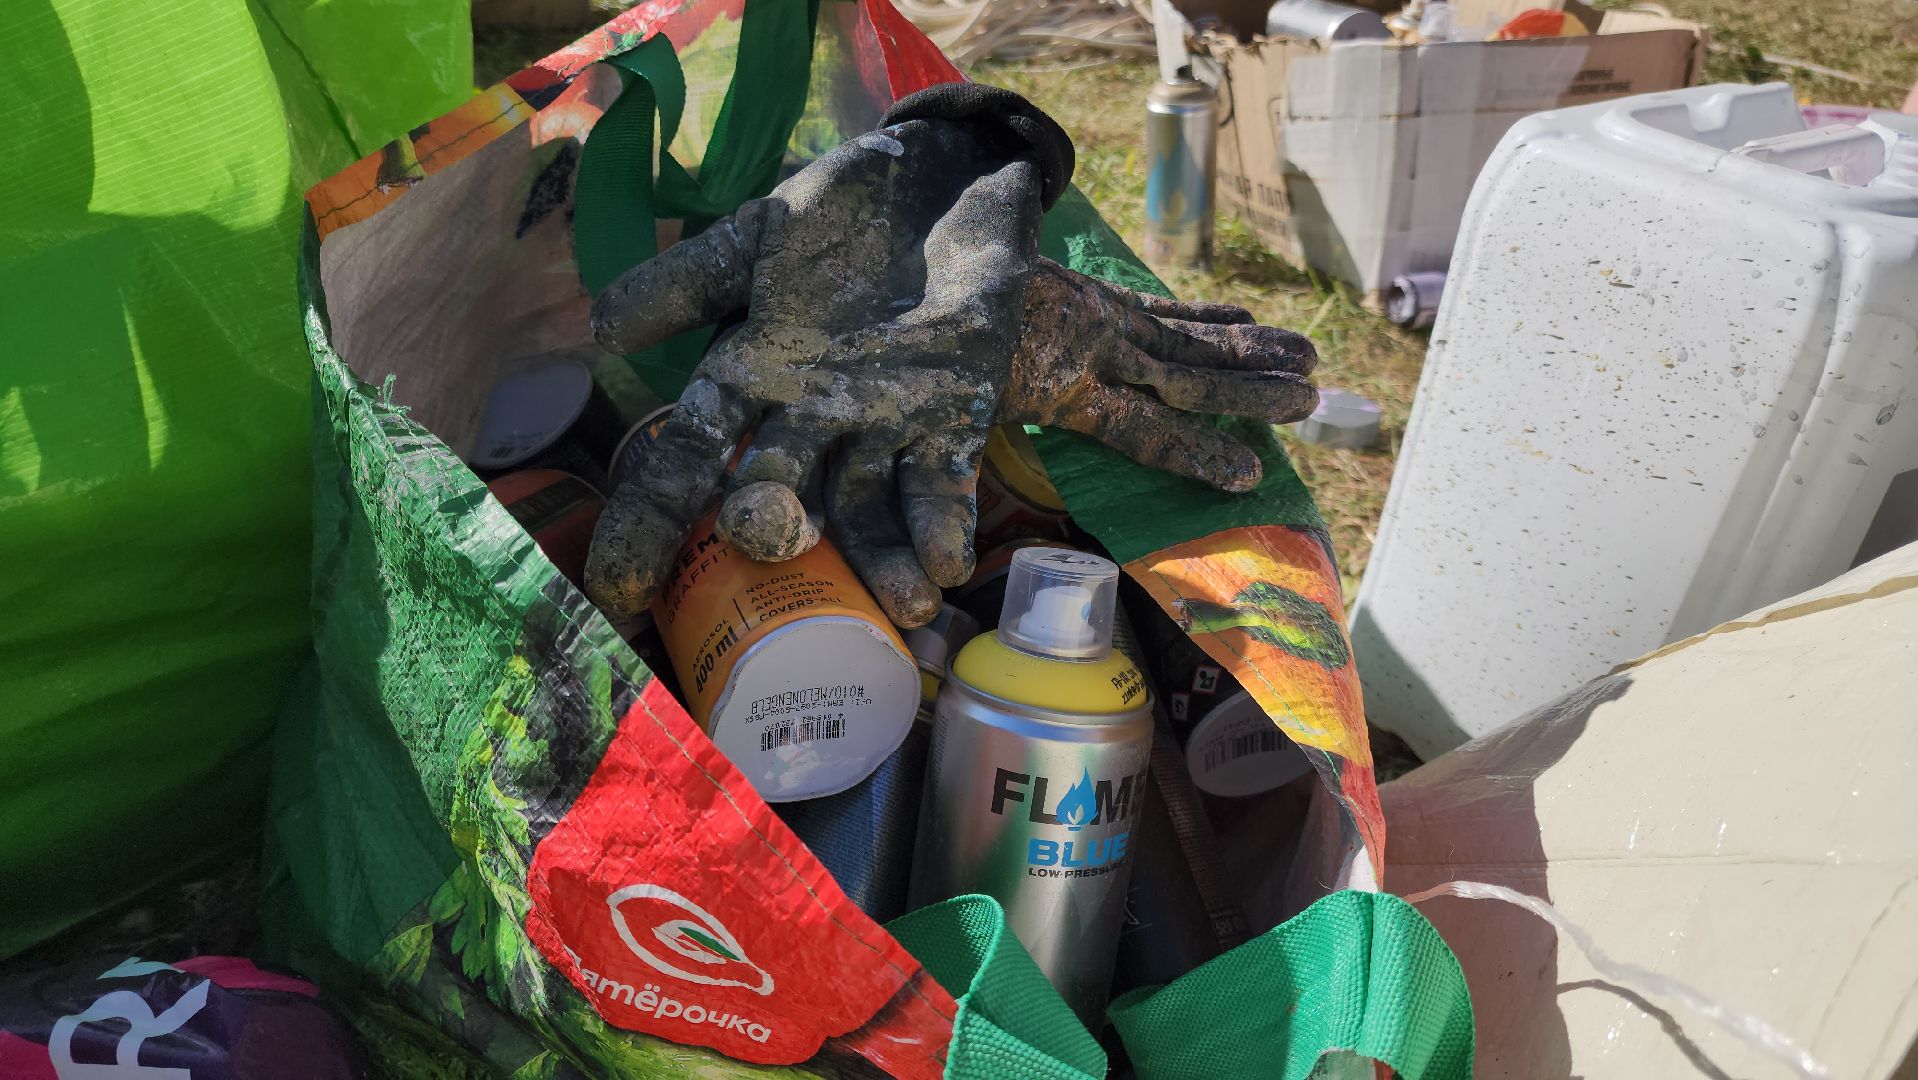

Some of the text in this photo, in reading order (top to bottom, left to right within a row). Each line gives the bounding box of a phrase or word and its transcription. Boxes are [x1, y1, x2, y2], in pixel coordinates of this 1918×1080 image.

[745, 572, 806, 595] NO-DUST
[751, 580, 834, 604] ALL-SEASON
[755, 588, 824, 613] ANTI-DRIP
[759, 597, 845, 622] COVERS-ALL
[692, 618, 729, 672] AEROSOL
[696, 625, 739, 695] 400 ml
[1027, 831, 1130, 868] BLUE
